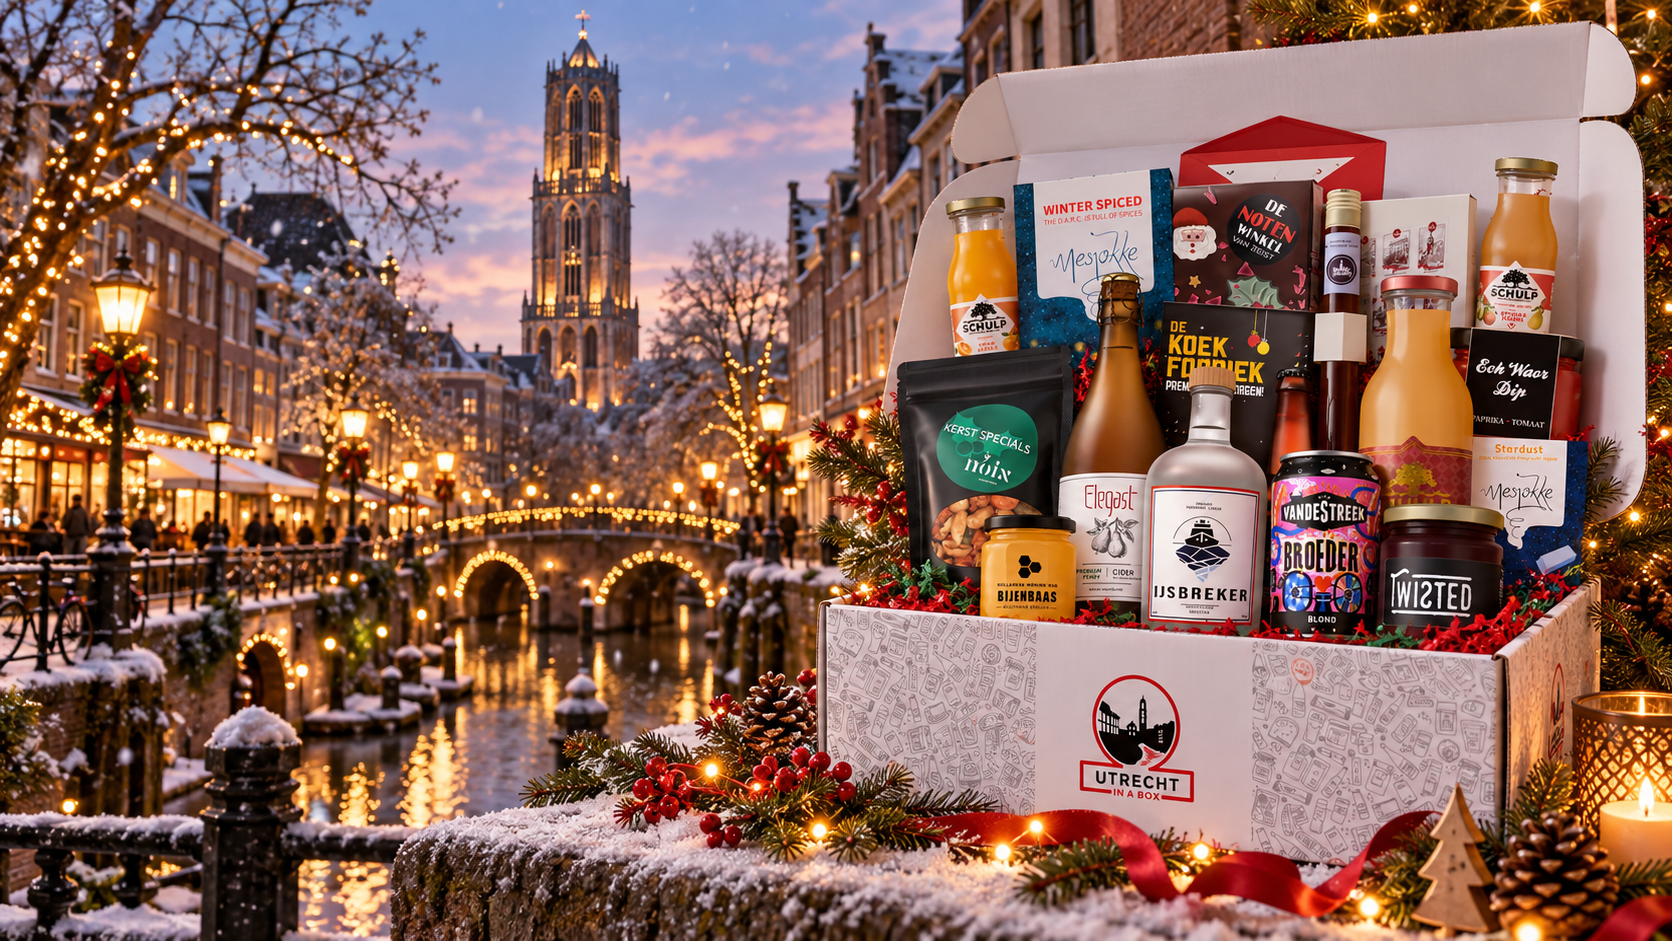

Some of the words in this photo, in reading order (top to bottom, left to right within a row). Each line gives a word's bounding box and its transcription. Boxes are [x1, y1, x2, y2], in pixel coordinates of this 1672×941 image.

[1043, 200, 1093, 216] WINTER
[1096, 195, 1143, 211] SPICED
[1118, 209, 1143, 219] SPICES
[1264, 199, 1288, 218] DE
[1237, 205, 1297, 244] NOTEN
[1491, 288, 1538, 300] SCHULP
[962, 319, 1007, 334] SCHULP
[1170, 320, 1187, 333] DE
[1168, 333, 1229, 358] KOEK
[1492, 380, 1527, 402] Dip
[1511, 418, 1546, 429] TOMAAT
[943, 423, 979, 438] KERST
[979, 430, 1031, 455] SPECIALS
[1494, 443, 1544, 454] Stardust
[1084, 484, 1138, 517] Elegast
[1480, 473, 1554, 511] Mesjokke
[1283, 500, 1365, 523] VANDESTREEK
[1283, 539, 1359, 573] BROEDER
[997, 590, 1057, 603] BIJENBAAS
[1154, 585, 1248, 602] IJSBREKER
[1390, 568, 1472, 611] TWISTED
[1307, 614, 1337, 624] BLOND
[1095, 770, 1179, 791] UTRECHT
[1113, 788, 1124, 797] IN
[1126, 790, 1134, 798] A
[1137, 791, 1160, 801] BOX
